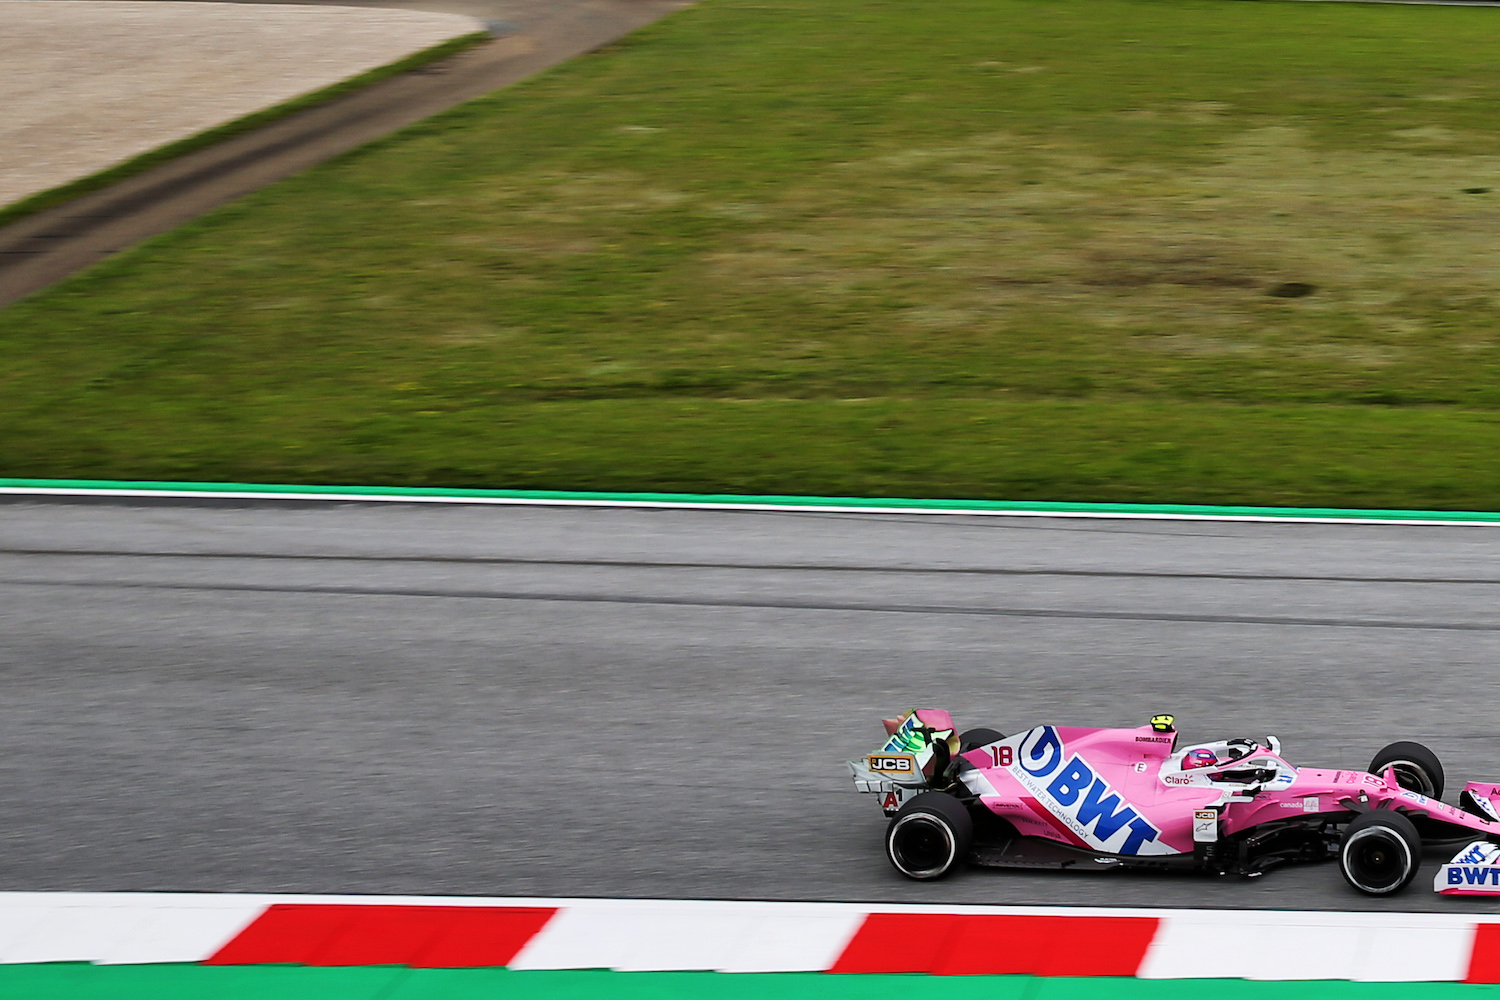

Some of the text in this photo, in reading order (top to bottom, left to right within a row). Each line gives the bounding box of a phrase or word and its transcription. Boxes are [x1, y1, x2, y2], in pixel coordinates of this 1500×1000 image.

[1135, 736, 1171, 744] BOMBARDIER
[991, 746, 1012, 766] 18
[872, 759, 910, 770] JCB
[1165, 775, 1191, 785] Claro
[1012, 766, 1089, 839] BEST WATER TECHNOLOGY
[1046, 756, 1158, 855] BWT
